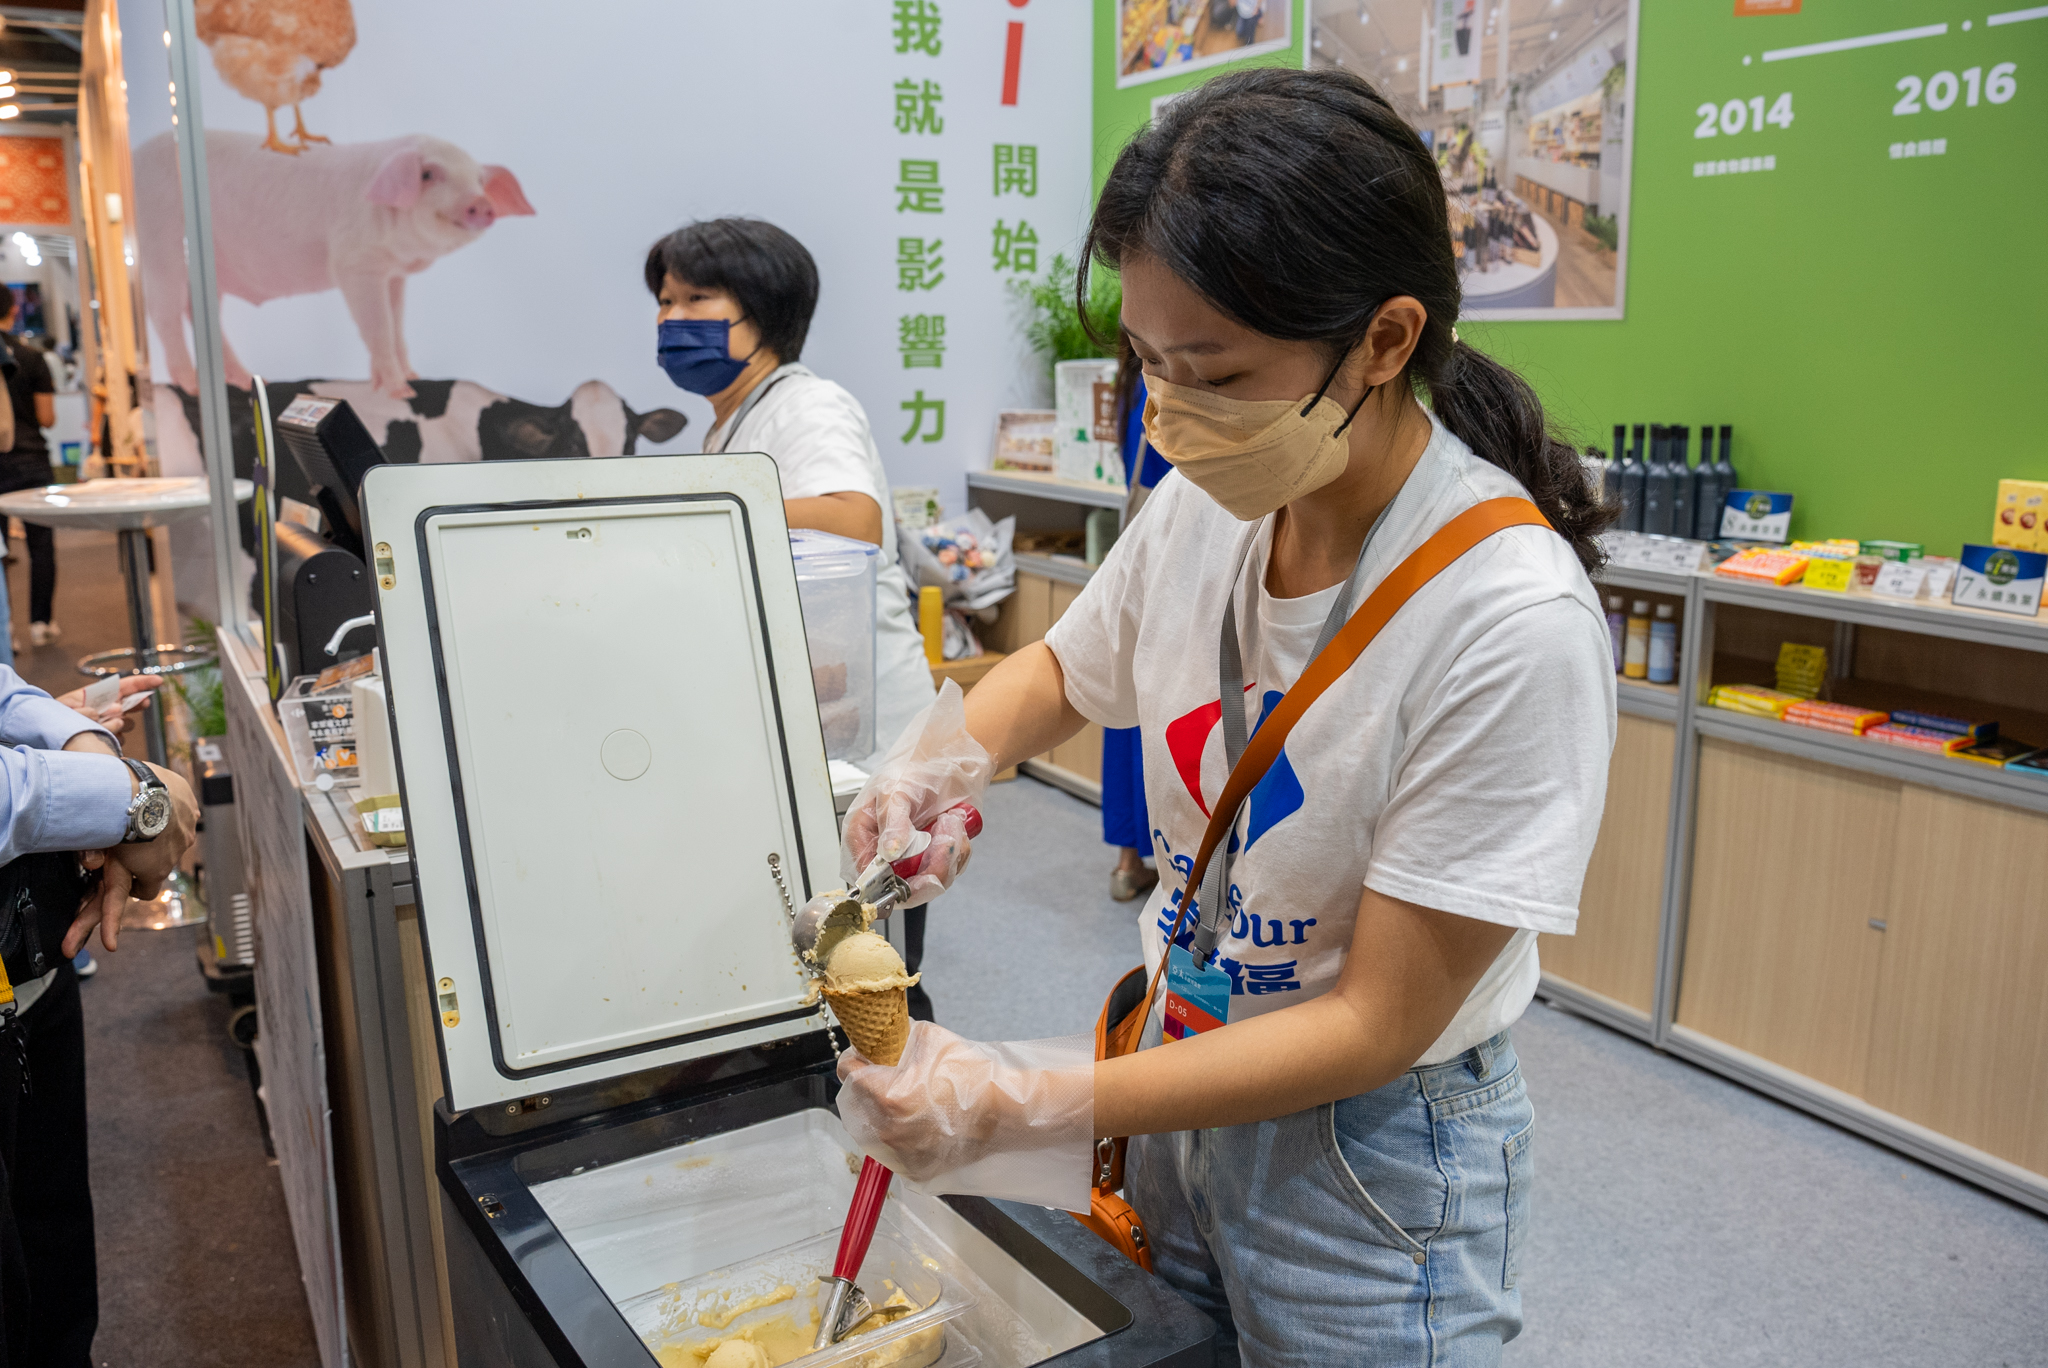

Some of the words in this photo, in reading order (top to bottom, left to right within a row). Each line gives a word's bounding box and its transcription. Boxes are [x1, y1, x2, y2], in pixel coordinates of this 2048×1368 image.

[1693, 92, 1796, 139] 2014
[1892, 62, 2018, 116] 2016
[892, 0, 947, 444] 我就是影響力
[991, 143, 1040, 274] 開始
[1169, 999, 1188, 1018] D-05
